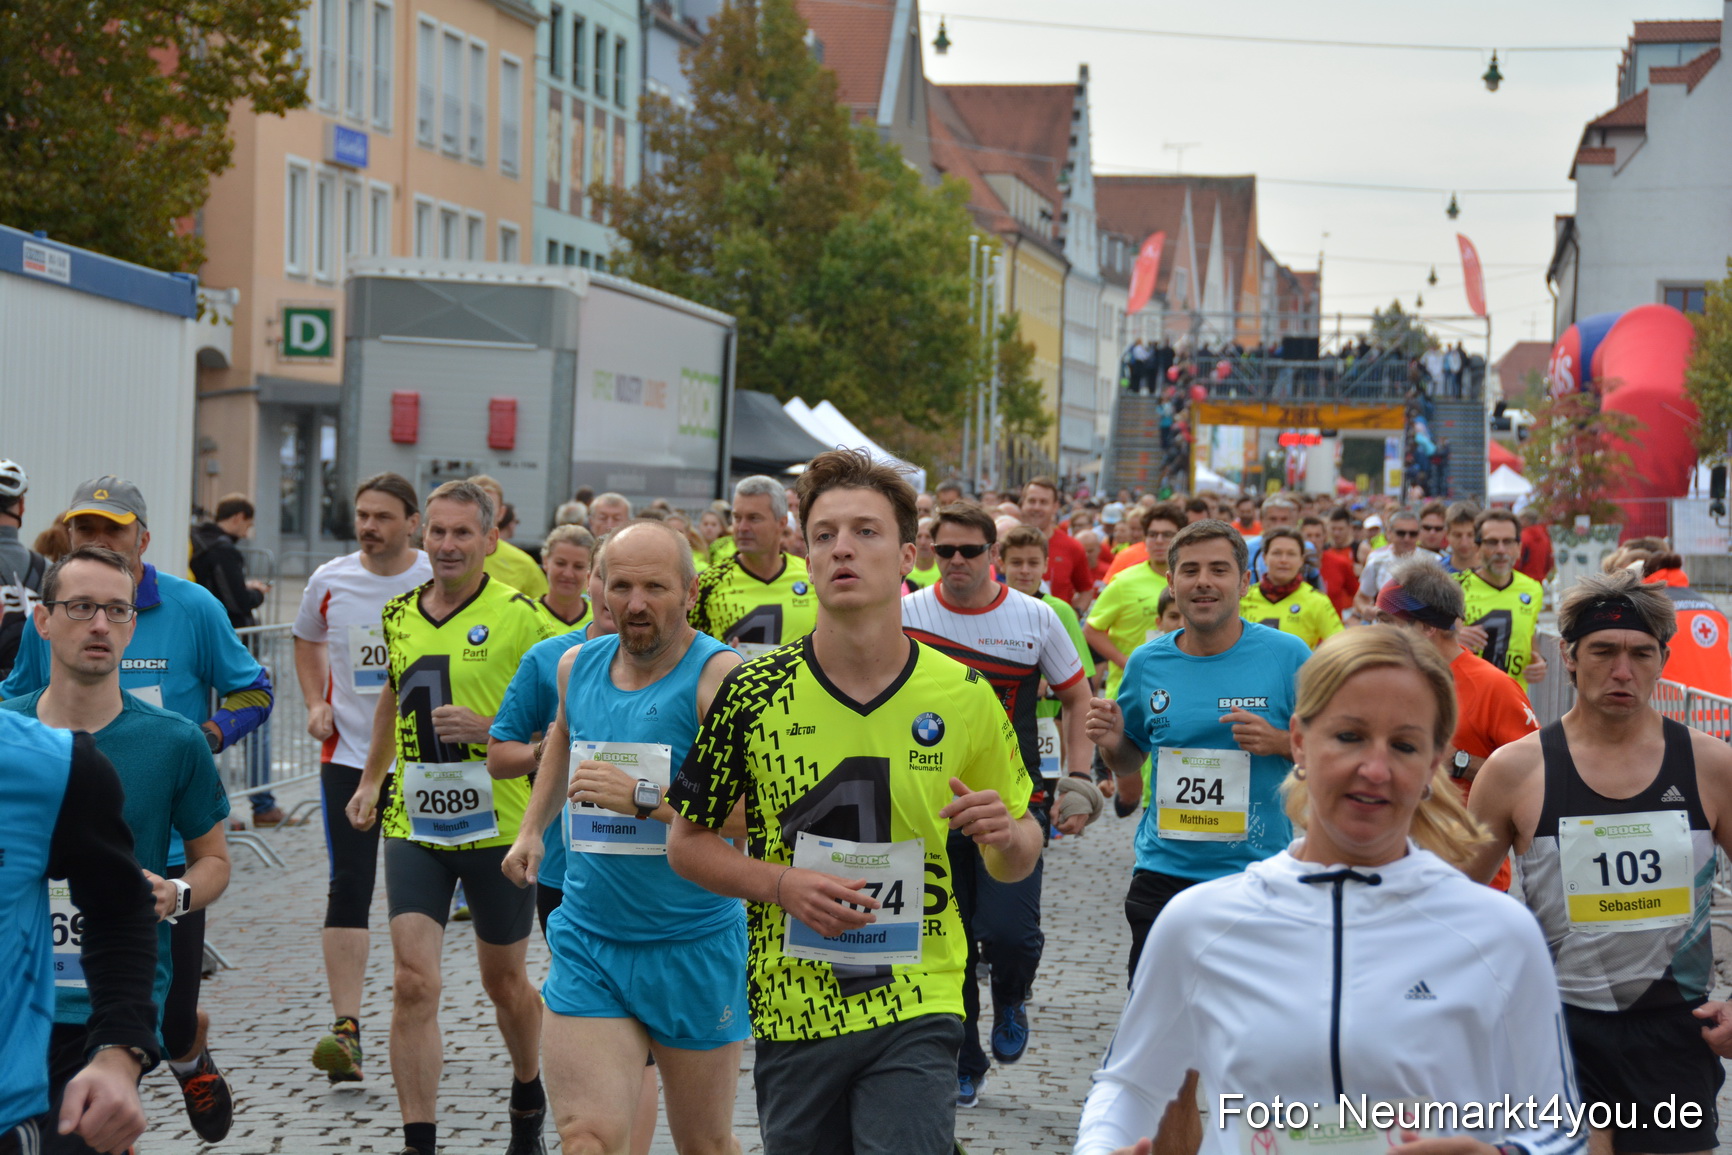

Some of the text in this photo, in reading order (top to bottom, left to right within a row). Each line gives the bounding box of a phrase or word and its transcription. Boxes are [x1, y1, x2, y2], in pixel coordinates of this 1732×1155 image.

[978, 638, 1026, 648] NEUMARKT
[463, 649, 488, 657] Partl
[121, 658, 168, 670] BOCK
[1218, 697, 1268, 708] BOCK
[601, 752, 639, 763] BOCK
[909, 750, 943, 765] Partl
[1190, 757, 1221, 766] BOCK
[909, 764, 942, 772] Neumarkt
[1176, 777, 1224, 806] 254
[416, 789, 479, 815] 2689
[1180, 813, 1219, 826] Matthias
[433, 820, 470, 833] Helmuth
[592, 821, 637, 835] Hermann
[1607, 824, 1652, 836] BOCK
[844, 854, 890, 865] BOCK
[1593, 849, 1662, 886] 103
[1599, 898, 1661, 912] Sebastian
[823, 930, 886, 943] onhard
